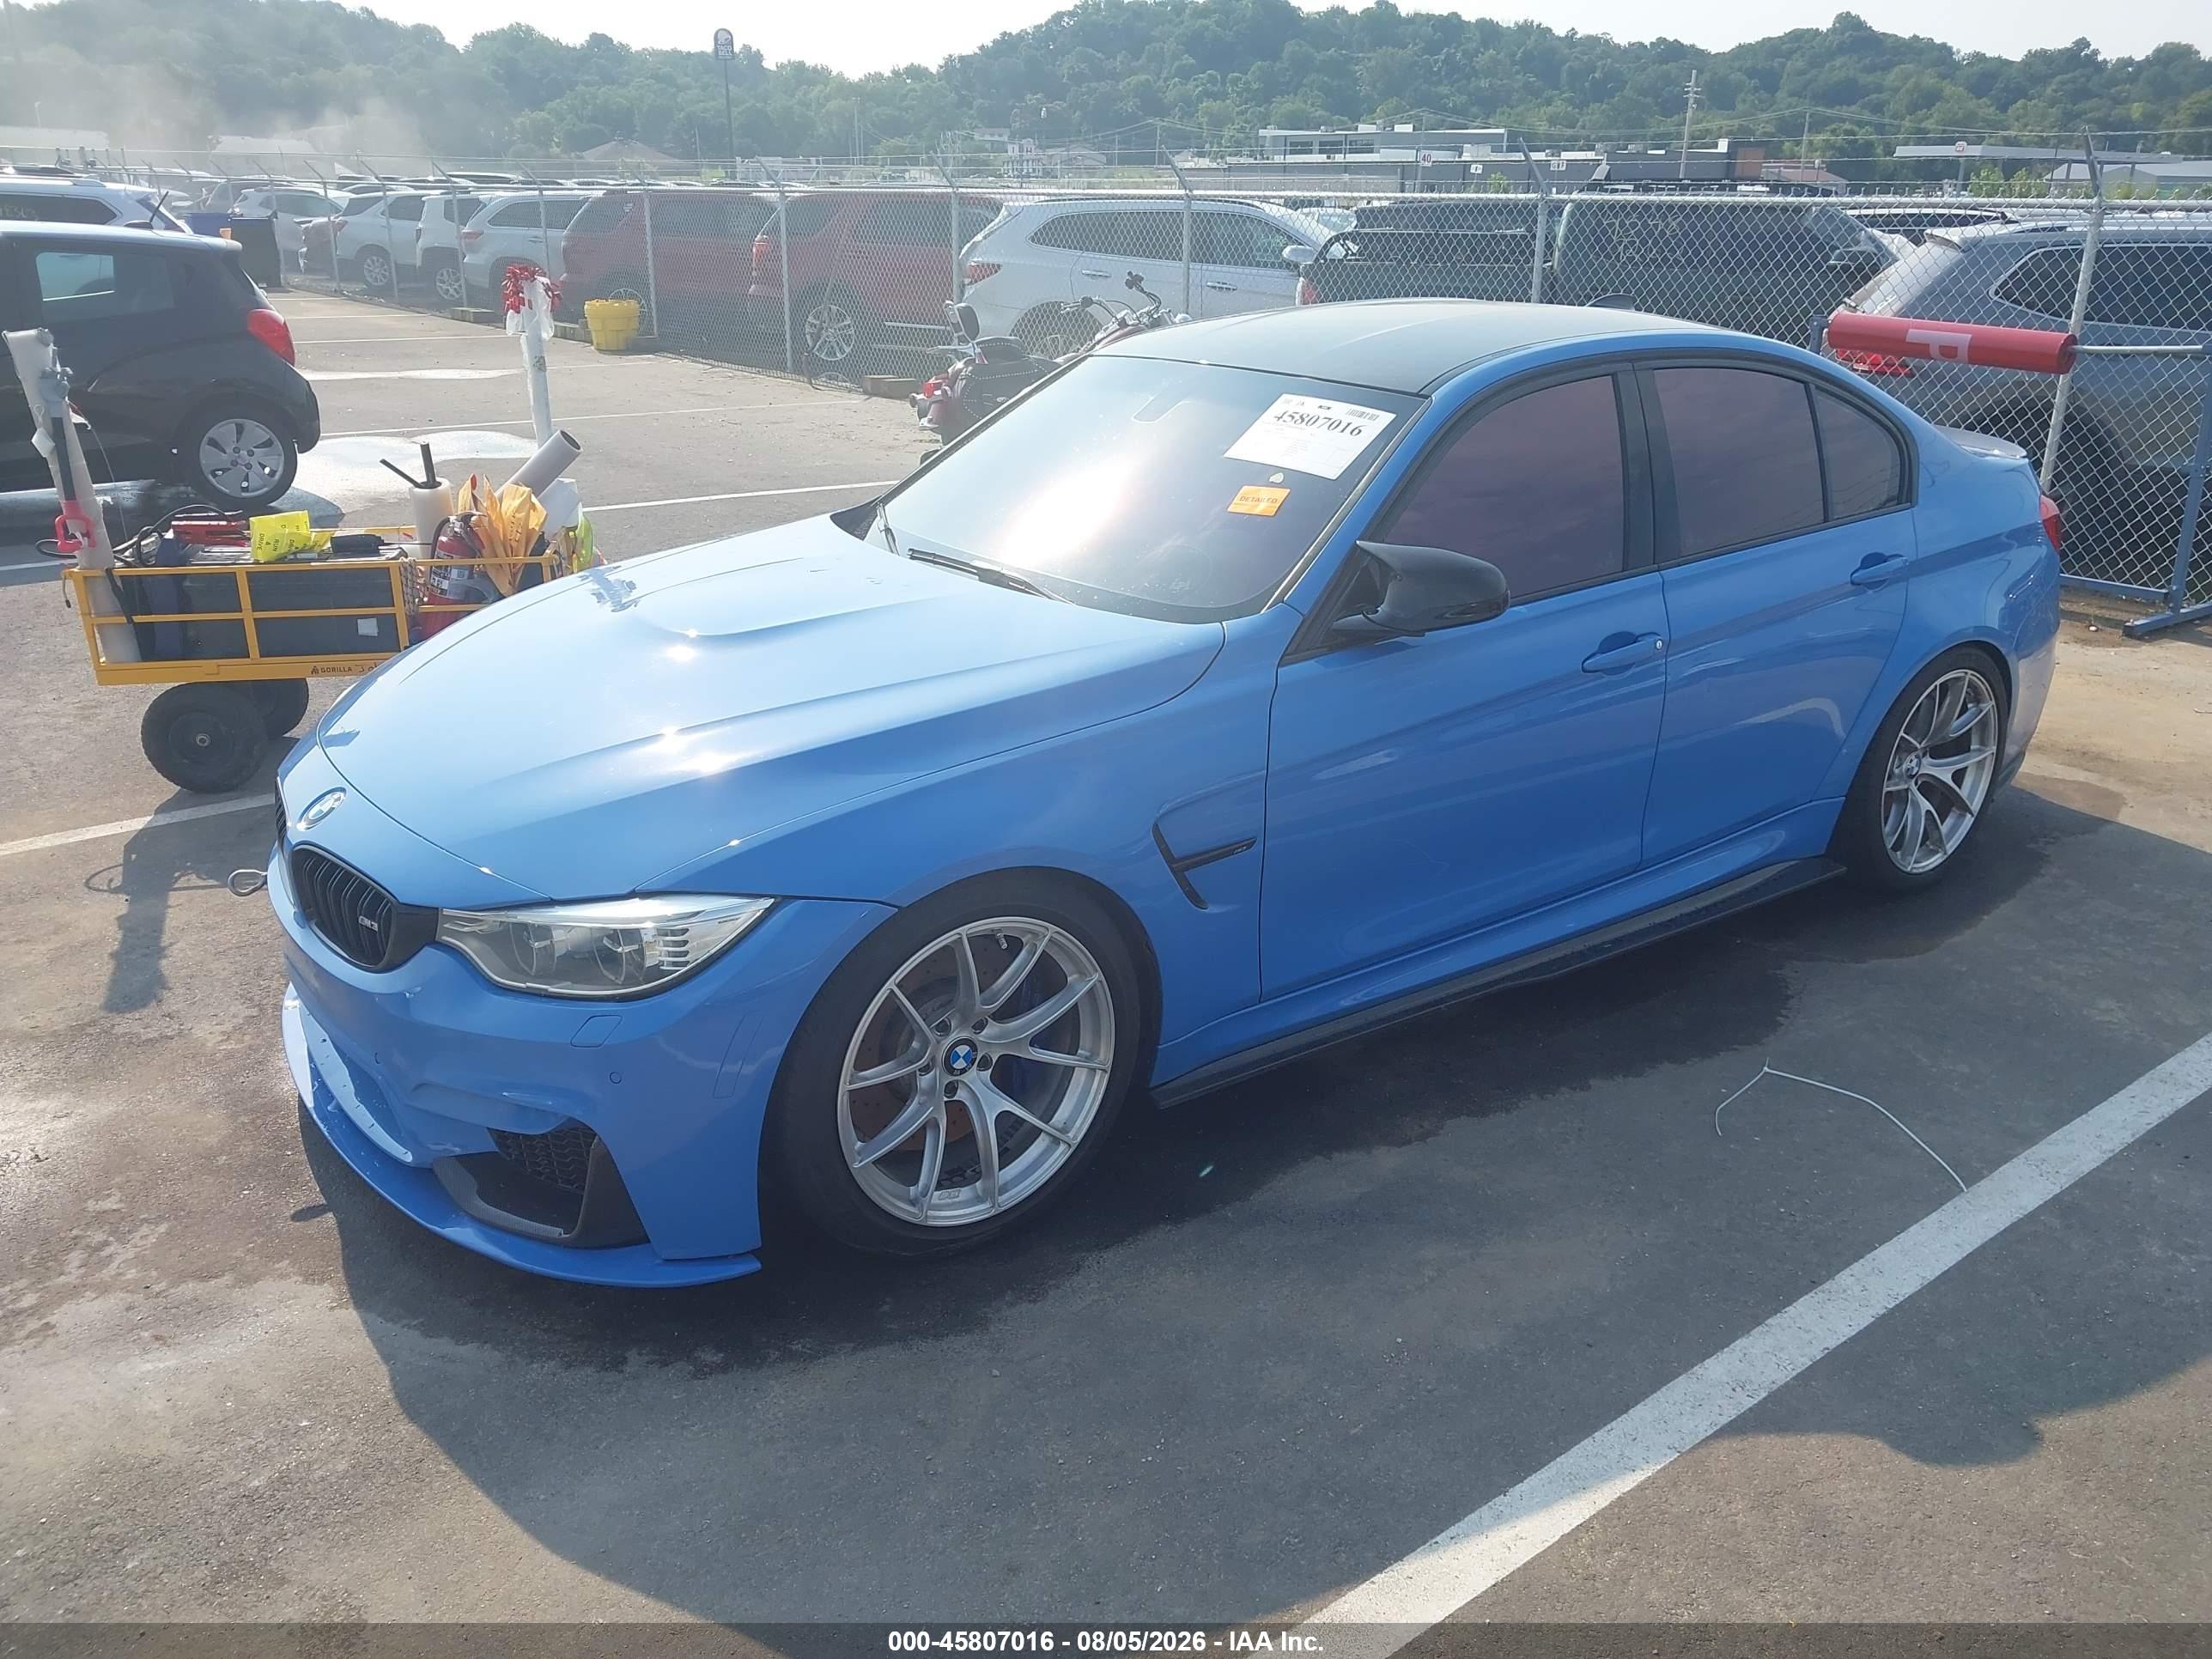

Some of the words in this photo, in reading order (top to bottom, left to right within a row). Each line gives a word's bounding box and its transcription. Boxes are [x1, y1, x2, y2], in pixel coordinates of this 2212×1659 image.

[1421, 154, 1431, 164] 40
[1273, 410, 1367, 437] 45807016
[256, 532, 265, 550] DRIVE
